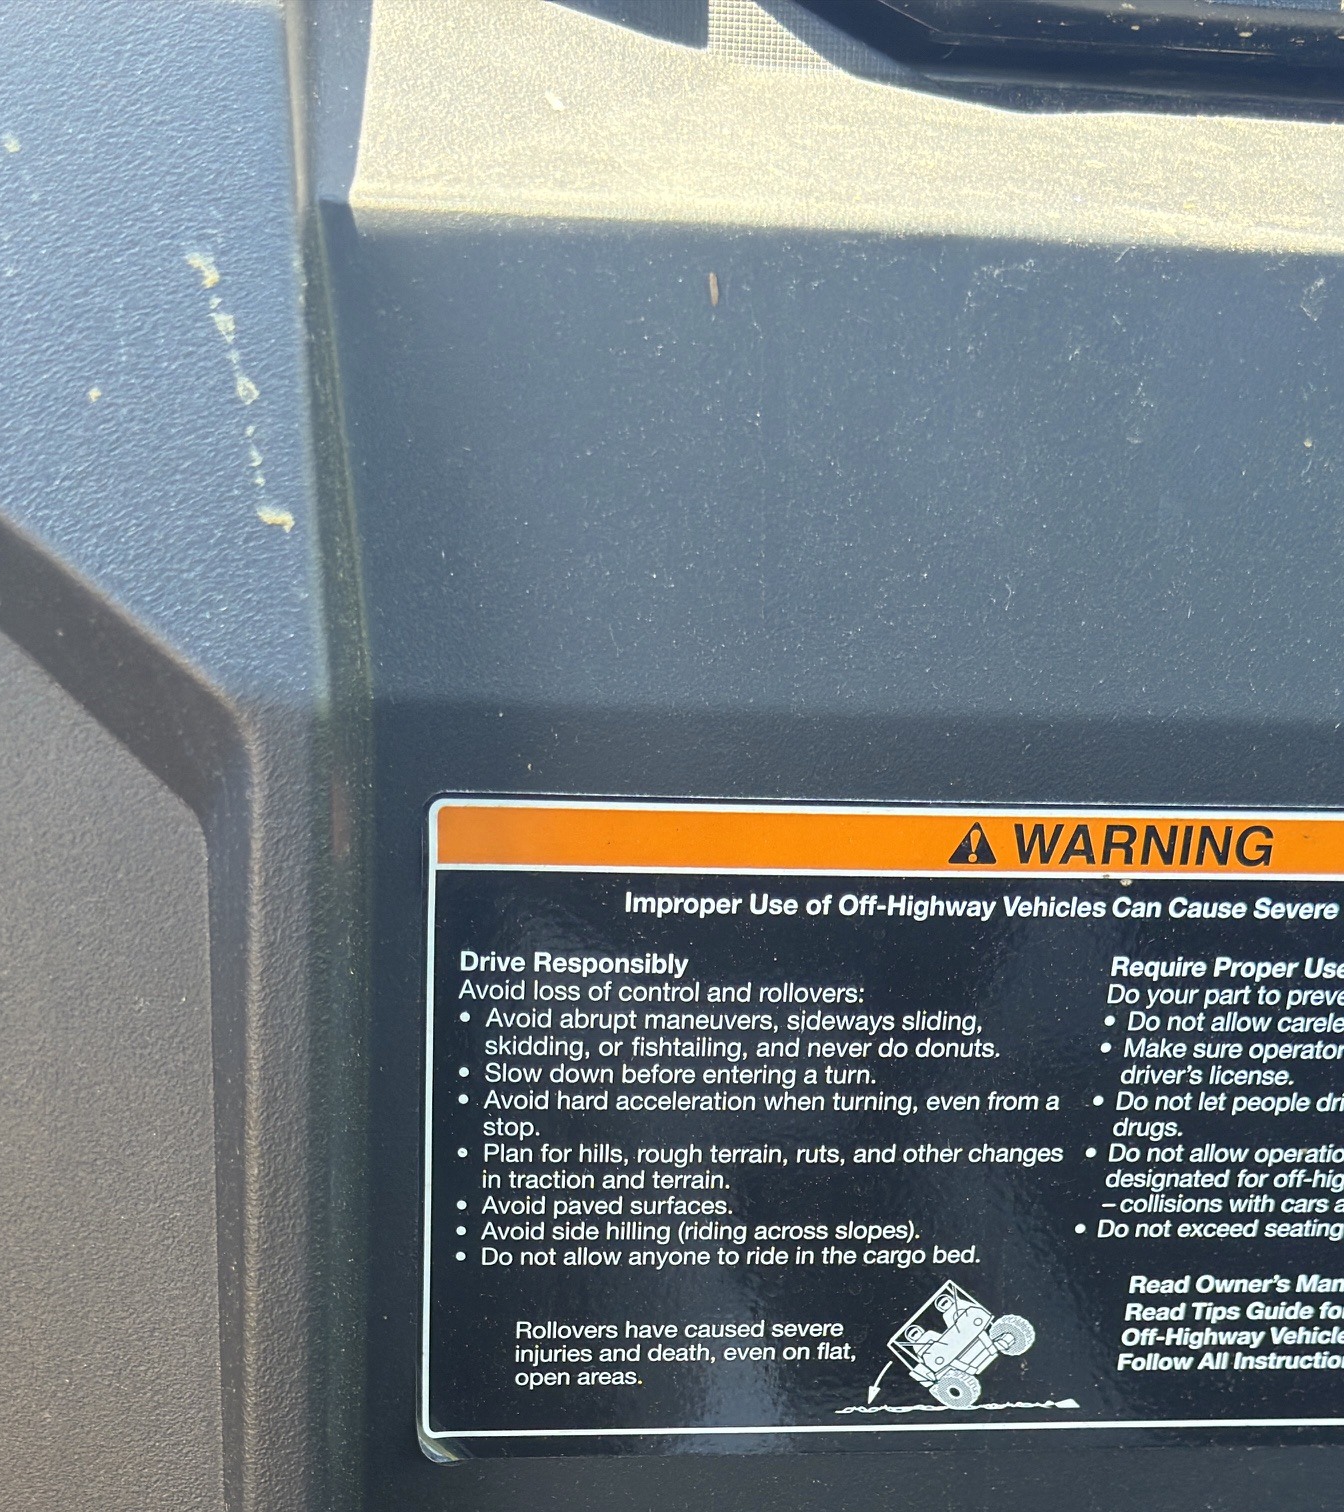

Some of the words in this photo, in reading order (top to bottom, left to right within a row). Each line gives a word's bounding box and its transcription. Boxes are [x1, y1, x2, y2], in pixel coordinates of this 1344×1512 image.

[1014, 823, 1274, 867] WARNING
[625, 891, 742, 918] Improper
[749, 893, 798, 915] Use
[805, 894, 832, 915] of
[838, 894, 996, 921] Off-Highway
[1003, 896, 1106, 917] Vehicles
[1112, 898, 1161, 917] Can
[1168, 898, 1247, 918] Cause
[1253, 899, 1339, 919] Severe
[460, 950, 525, 971] Drive
[533, 951, 688, 978] Responsibly
[1110, 955, 1206, 981] Require
[1213, 956, 1299, 982] Proper
[458, 979, 525, 999] Avoid
[534, 979, 580, 1000] loss
[588, 980, 612, 1001] of
[618, 981, 699, 1001] control
[706, 981, 751, 1002] and
[759, 982, 863, 1003] rollovers:
[1106, 983, 1139, 1003] Do
[1145, 988, 1199, 1009] your
[1203, 985, 1251, 1009] part
[1257, 985, 1280, 1005] to
[485, 1007, 551, 1027] Avoid
[559, 1007, 637, 1034] abrupt
[644, 1013, 777, 1033] maneuvers,
[786, 1009, 894, 1035] sideways
[901, 1010, 981, 1035] sliding,
[1127, 1010, 1160, 1031] Do
[1166, 1012, 1205, 1031] not
[1210, 1011, 1272, 1031] allow
[484, 1035, 589, 1061] skidding,
[598, 1041, 623, 1056] or
[631, 1036, 747, 1061] fishtailing,
[756, 1037, 799, 1057] and
[807, 1042, 872, 1057] never
[878, 1037, 907, 1057] do
[915, 1037, 999, 1057] donuts.
[1123, 1037, 1187, 1058] Make
[1192, 1042, 1242, 1058] sure
[484, 1062, 542, 1082] Slow
[549, 1062, 613, 1083] down
[621, 1063, 695, 1083] before
[702, 1064, 796, 1089] entering
[803, 1069, 817, 1084] a
[824, 1065, 875, 1084] turn.
[1209, 1064, 1293, 1085] license.
[1112, 1117, 1182, 1141] drugs.
[1105, 1168, 1230, 1192] designated
[1237, 1168, 1269, 1187] for
[481, 1195, 545, 1214] Avoid
[553, 1195, 622, 1219] paved
[630, 1195, 732, 1214] surfaces.
[1128, 1274, 1190, 1293] Read
[1124, 1302, 1186, 1321] Read
[1191, 1302, 1240, 1323] Tips
[1245, 1301, 1314, 1319] Guide
[516, 1320, 618, 1338] Rollovers
[625, 1320, 677, 1338] have
[684, 1319, 764, 1337] caused
[771, 1322, 843, 1337] severe
[1121, 1327, 1265, 1349] Off-Highway
[515, 1344, 592, 1366] injuries
[598, 1343, 640, 1361] and
[647, 1342, 715, 1363] death,
[723, 1346, 775, 1360] even
[782, 1346, 809, 1359] on
[816, 1341, 855, 1361] flat,
[1117, 1352, 1194, 1370] Follow
[1196, 1351, 1229, 1369] All
[514, 1371, 569, 1389] open
[577, 1371, 642, 1385] areas.
